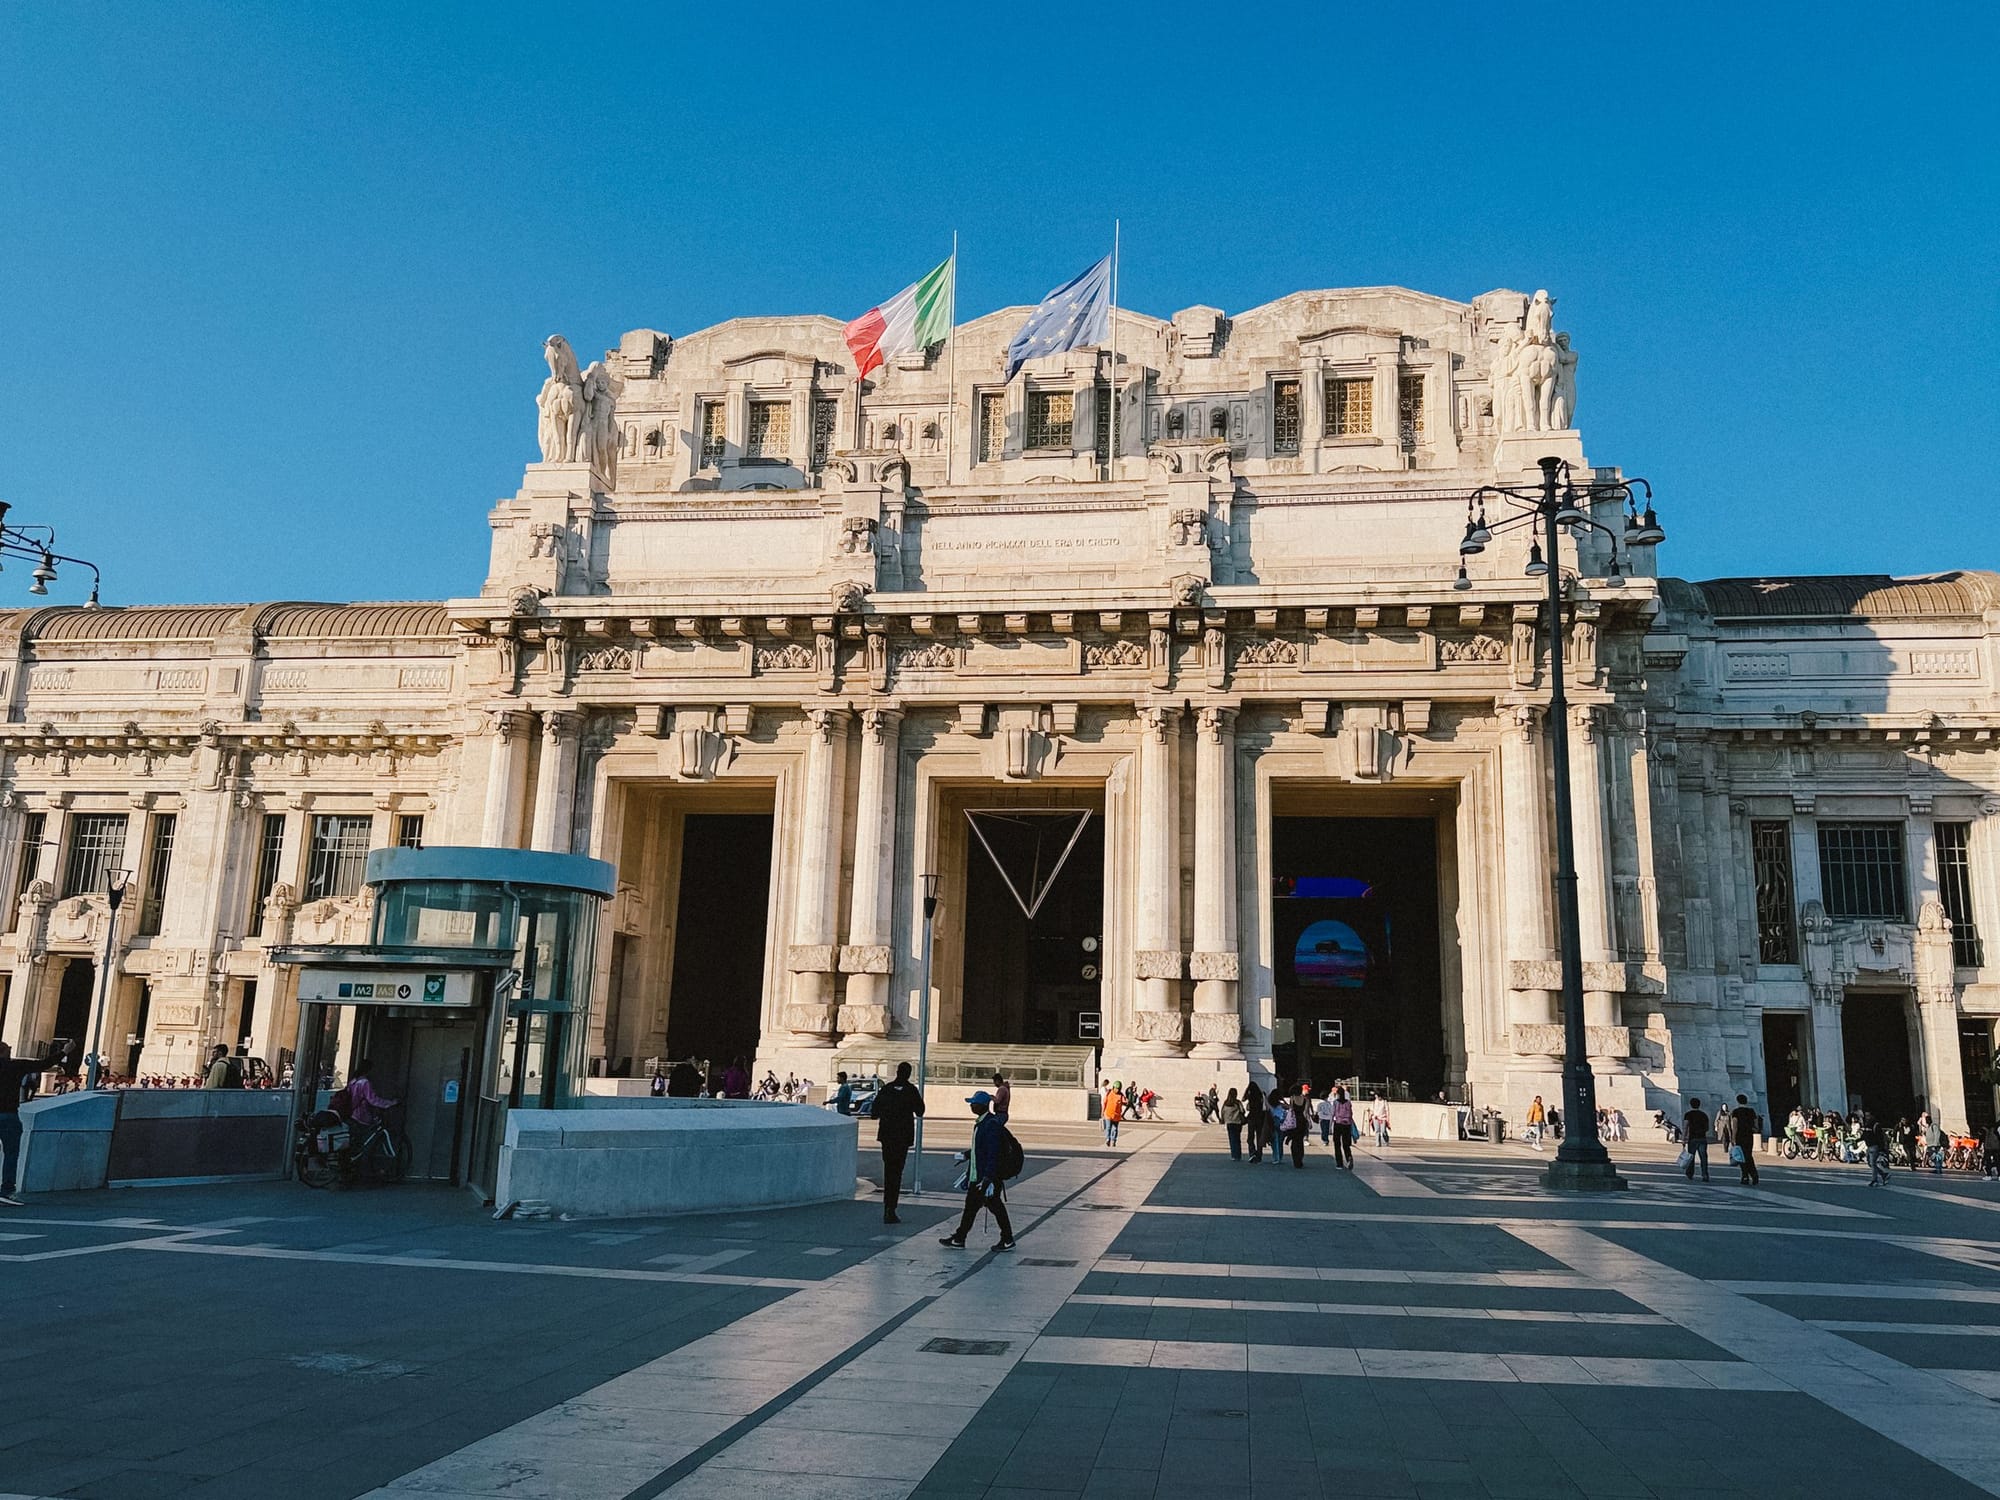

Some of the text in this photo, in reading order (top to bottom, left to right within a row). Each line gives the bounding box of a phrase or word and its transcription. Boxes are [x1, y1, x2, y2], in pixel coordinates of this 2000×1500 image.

[956, 541, 982, 550] ANNO
[1055, 538, 1073, 547] ERA
[1075, 538, 1085, 547] DI
[1088, 537, 1120, 547] CRISTO
[356, 986, 394, 996] M2 M3
